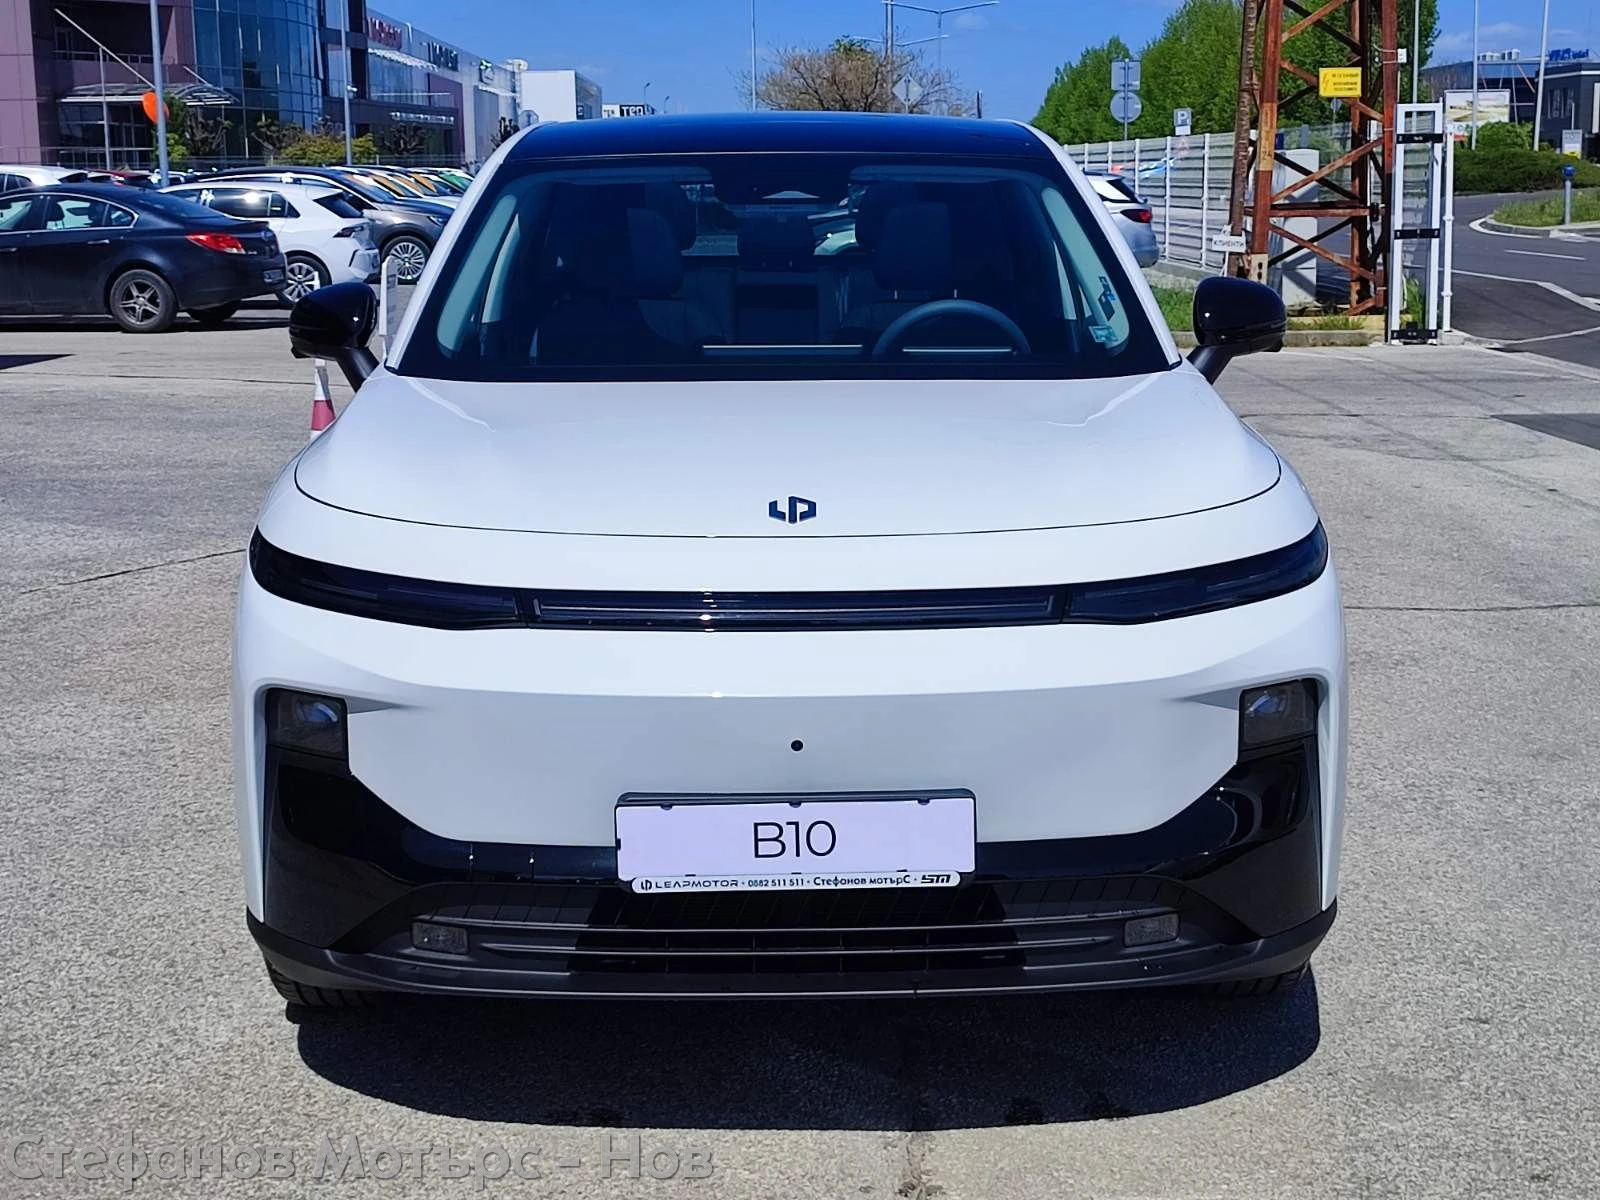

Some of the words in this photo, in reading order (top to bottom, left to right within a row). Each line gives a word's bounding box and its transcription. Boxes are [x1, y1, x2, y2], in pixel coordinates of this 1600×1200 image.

[1177, 110, 1189, 125] P
[753, 819, 837, 859] B10
[655, 879, 739, 889] LEAPMOTOR
[748, 879, 769, 888] 0882
[771, 878, 787, 887] 511
[789, 877, 804, 886] 511
[813, 876, 867, 887] Стефанов
